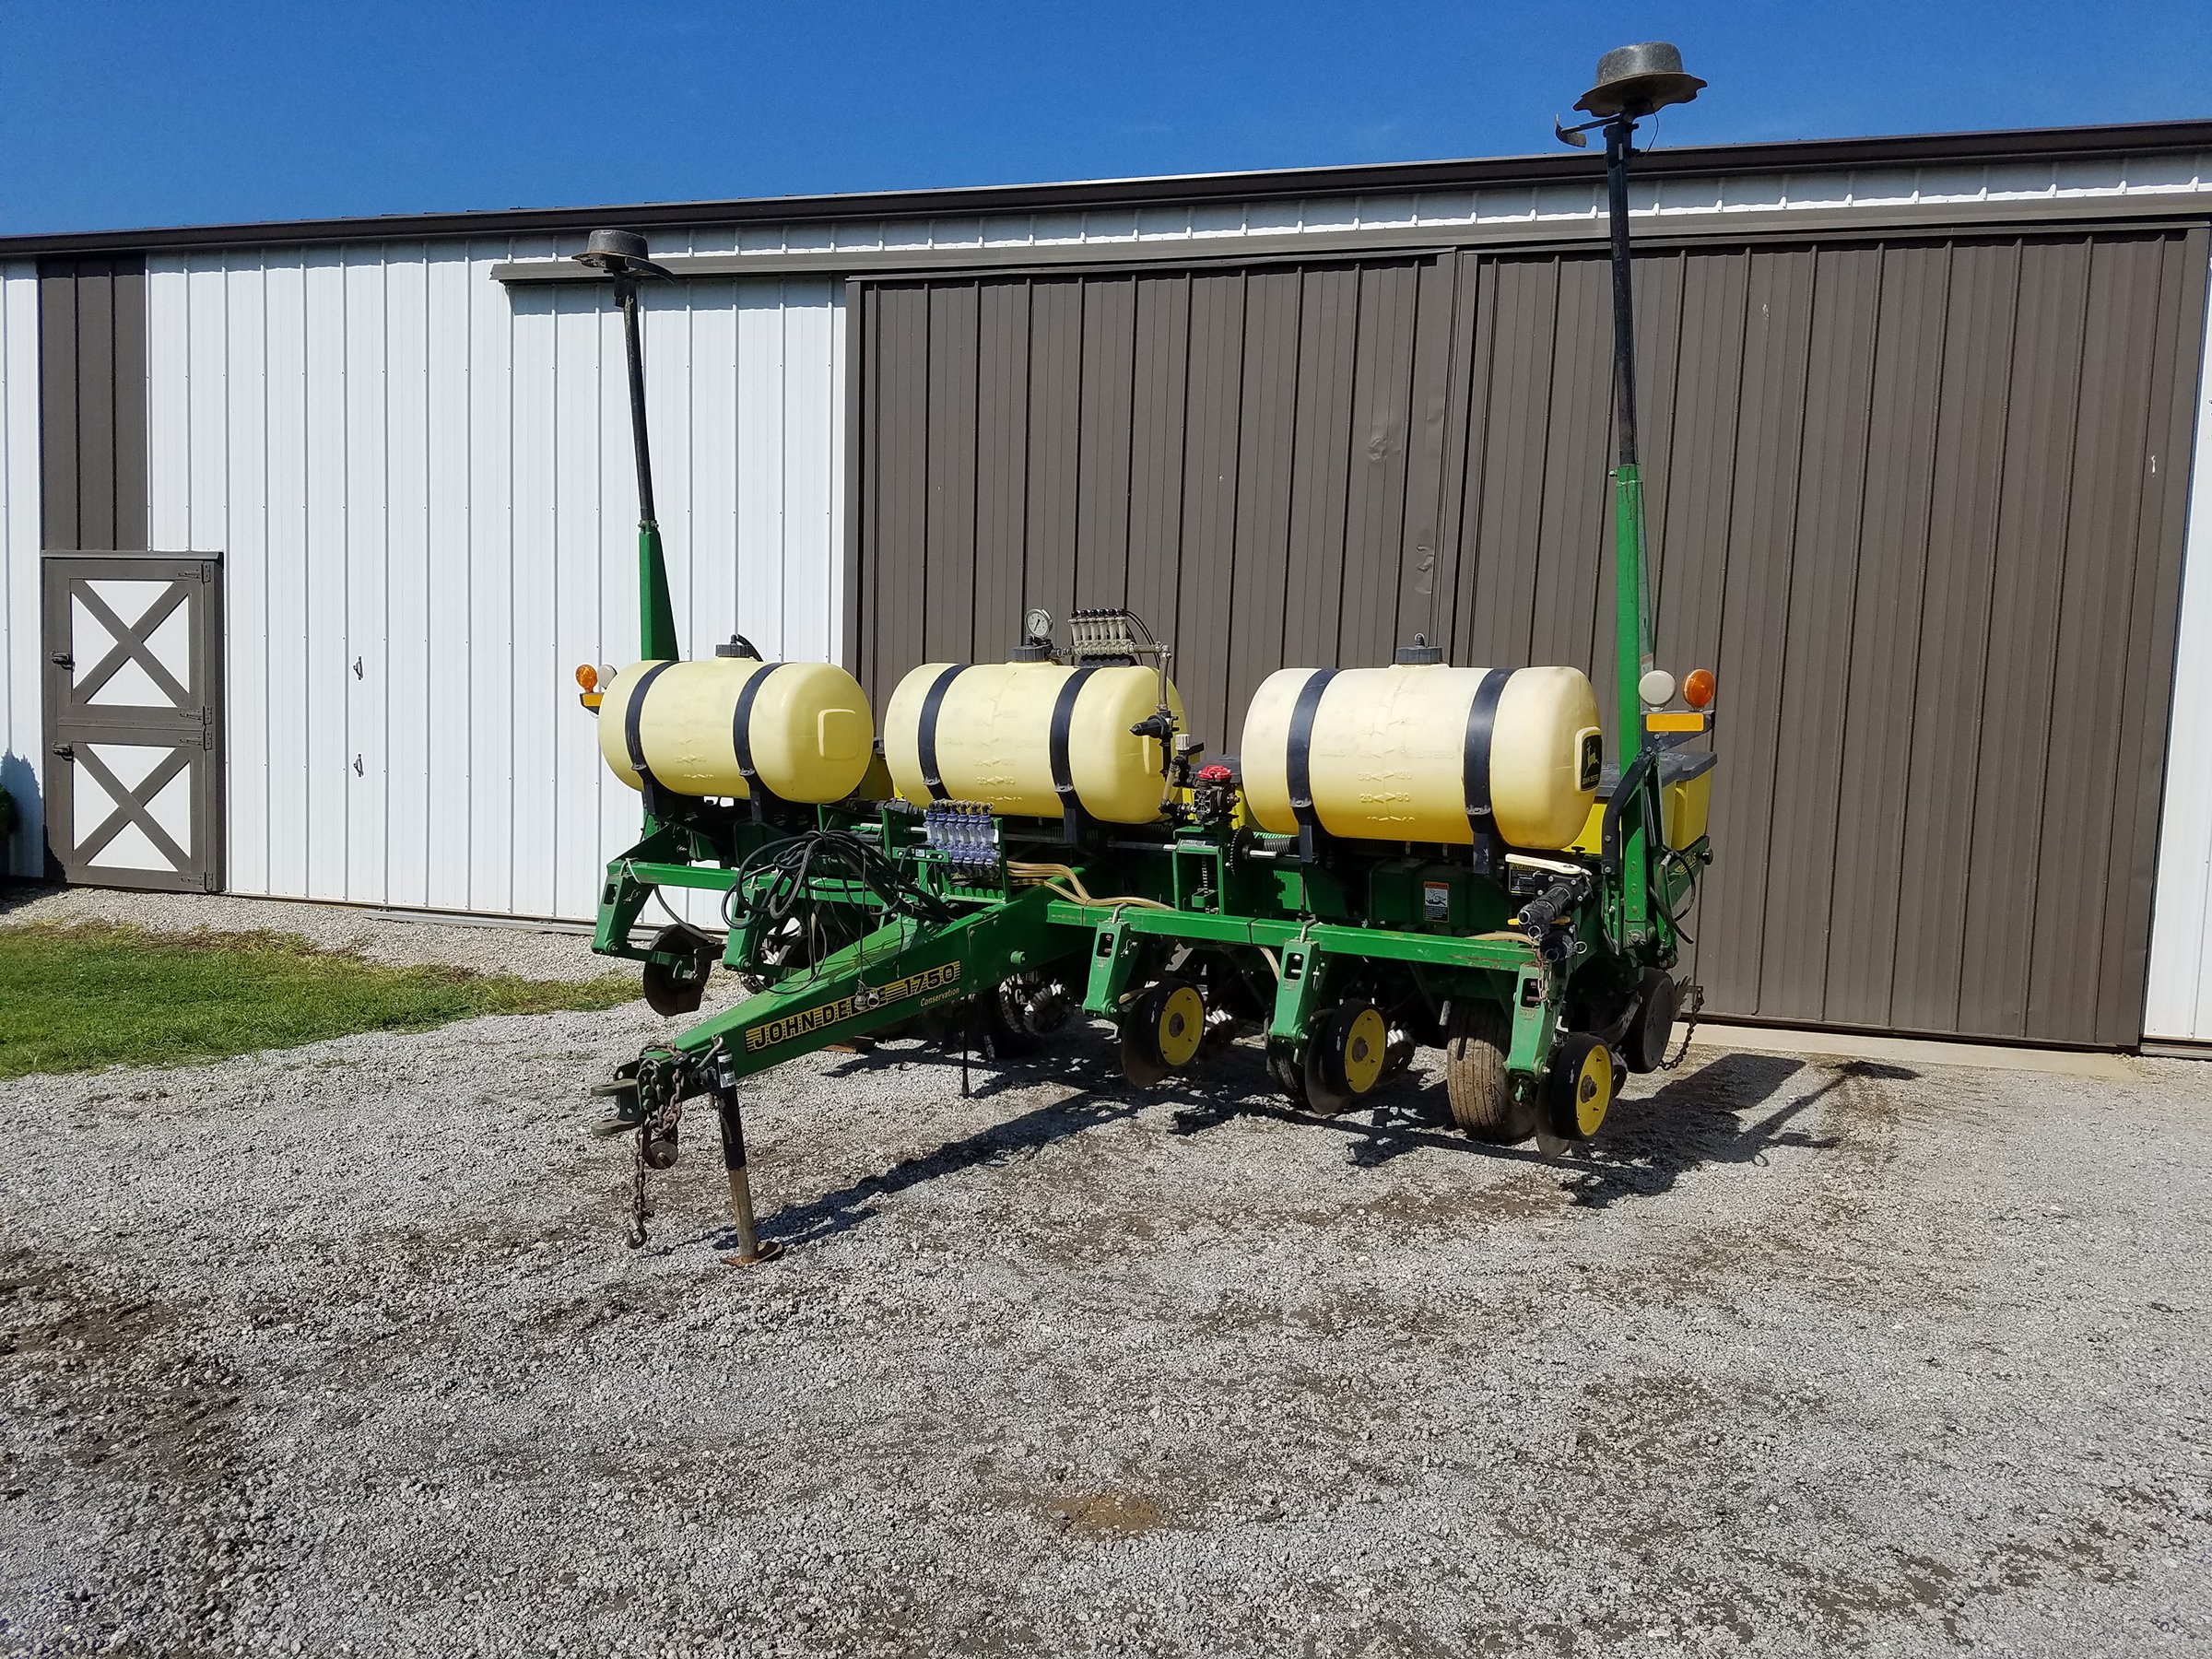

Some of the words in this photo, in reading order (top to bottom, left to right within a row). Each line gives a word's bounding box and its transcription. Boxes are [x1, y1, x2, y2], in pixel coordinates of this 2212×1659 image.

[1359, 793, 1373, 803] 20
[754, 1013, 818, 1049] JOHN
[904, 963, 957, 996] 1750
[920, 987, 960, 1006] Conservation
